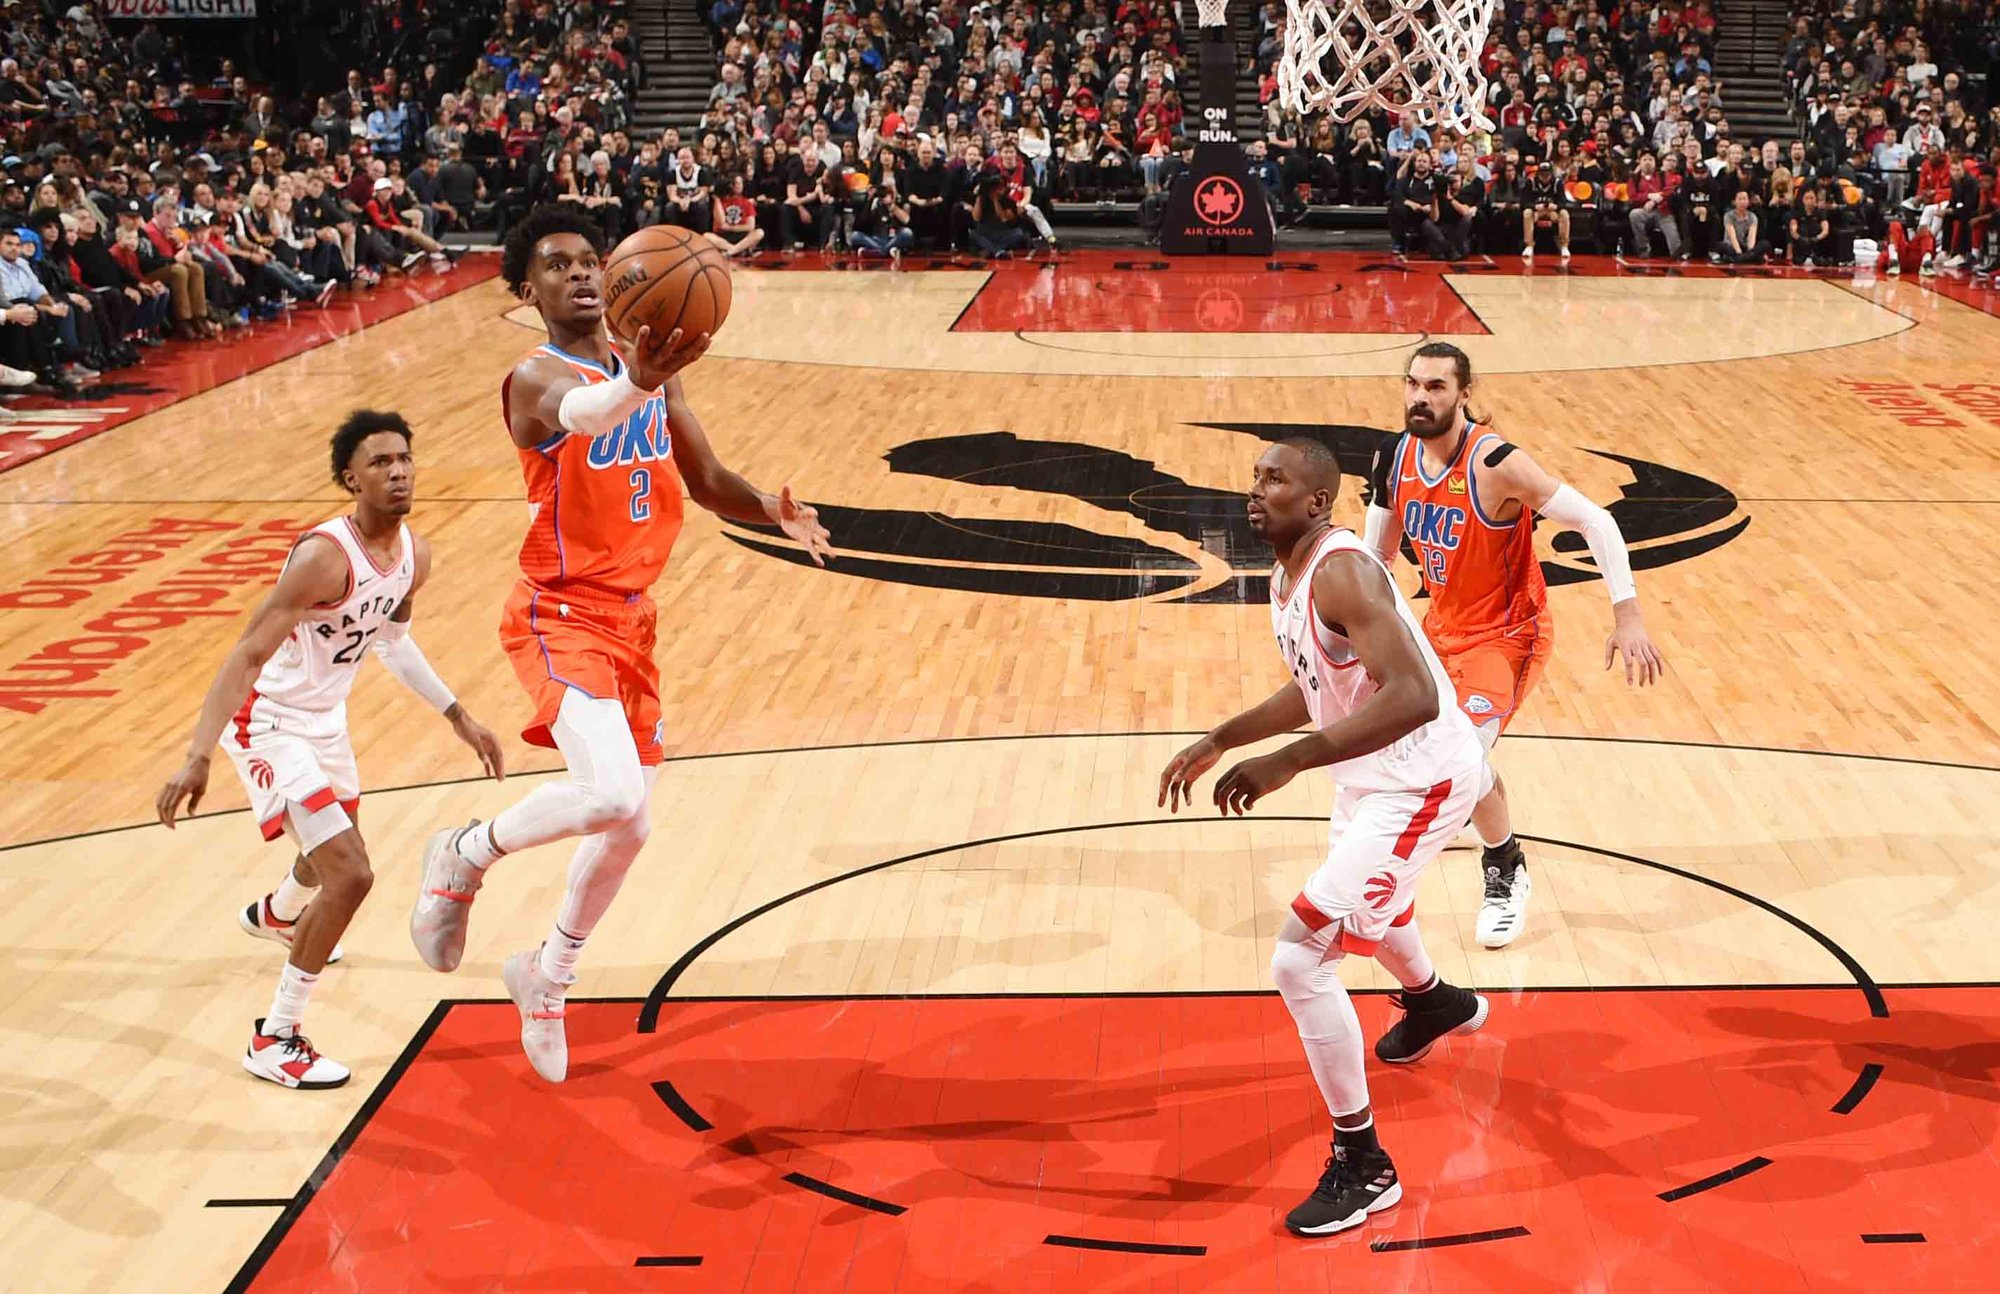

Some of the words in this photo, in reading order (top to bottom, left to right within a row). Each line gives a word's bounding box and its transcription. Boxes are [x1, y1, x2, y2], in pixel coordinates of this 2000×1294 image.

[1203, 107, 1227, 120] ON
[1199, 130, 1238, 142] RUN.
[1184, 227, 1203, 236] AIR
[1206, 227, 1254, 236] CANADA
[586, 396, 672, 470] OKC
[629, 468, 651, 522] 2
[1403, 499, 1465, 550] OKC
[1421, 546, 1448, 586] 12
[316, 596, 394, 639] RAPTO
